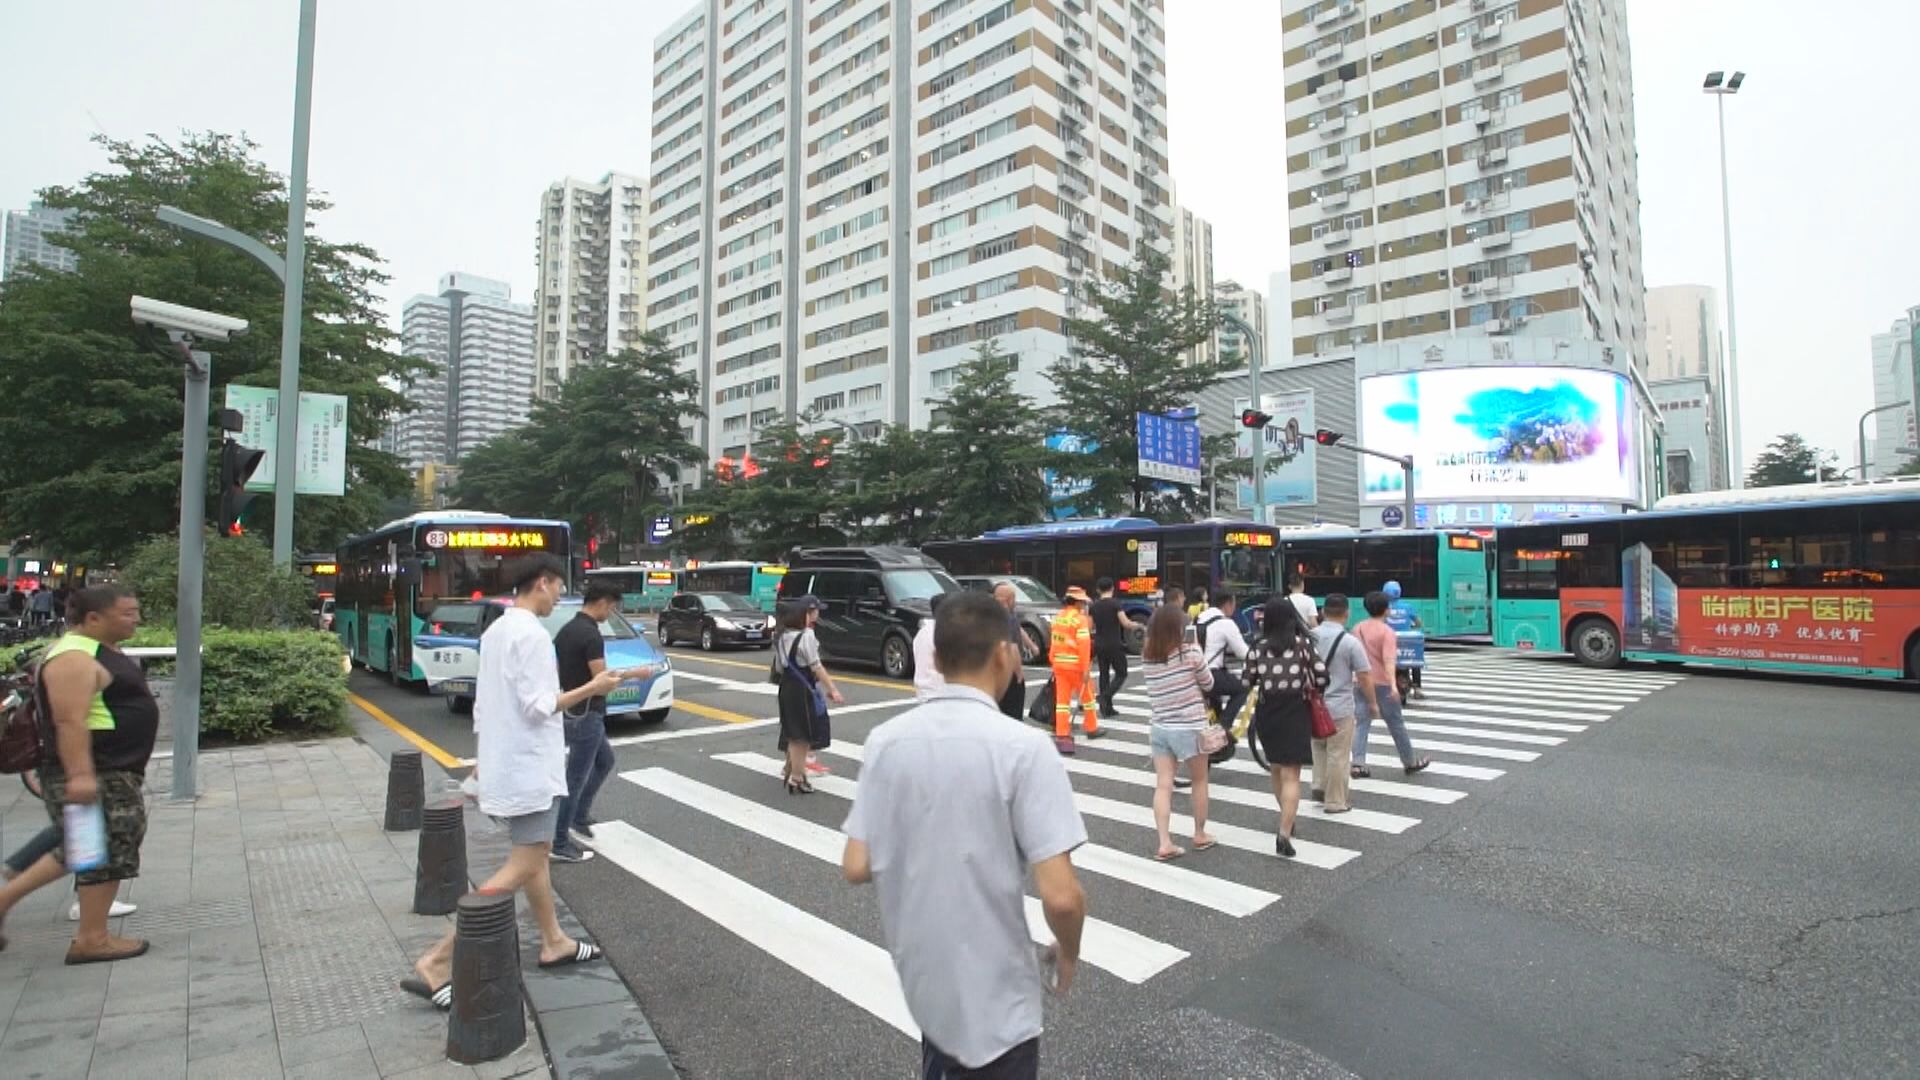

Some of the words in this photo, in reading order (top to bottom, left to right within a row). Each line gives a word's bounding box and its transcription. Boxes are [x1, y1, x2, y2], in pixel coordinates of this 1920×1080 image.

[430, 533, 446, 544] 83
[1702, 595, 1874, 621] 怡康妇产医院
[1715, 622, 1780, 637] 科学助孕
[1796, 627, 1862, 641] 优生优育
[433, 650, 462, 664] 康达尔
